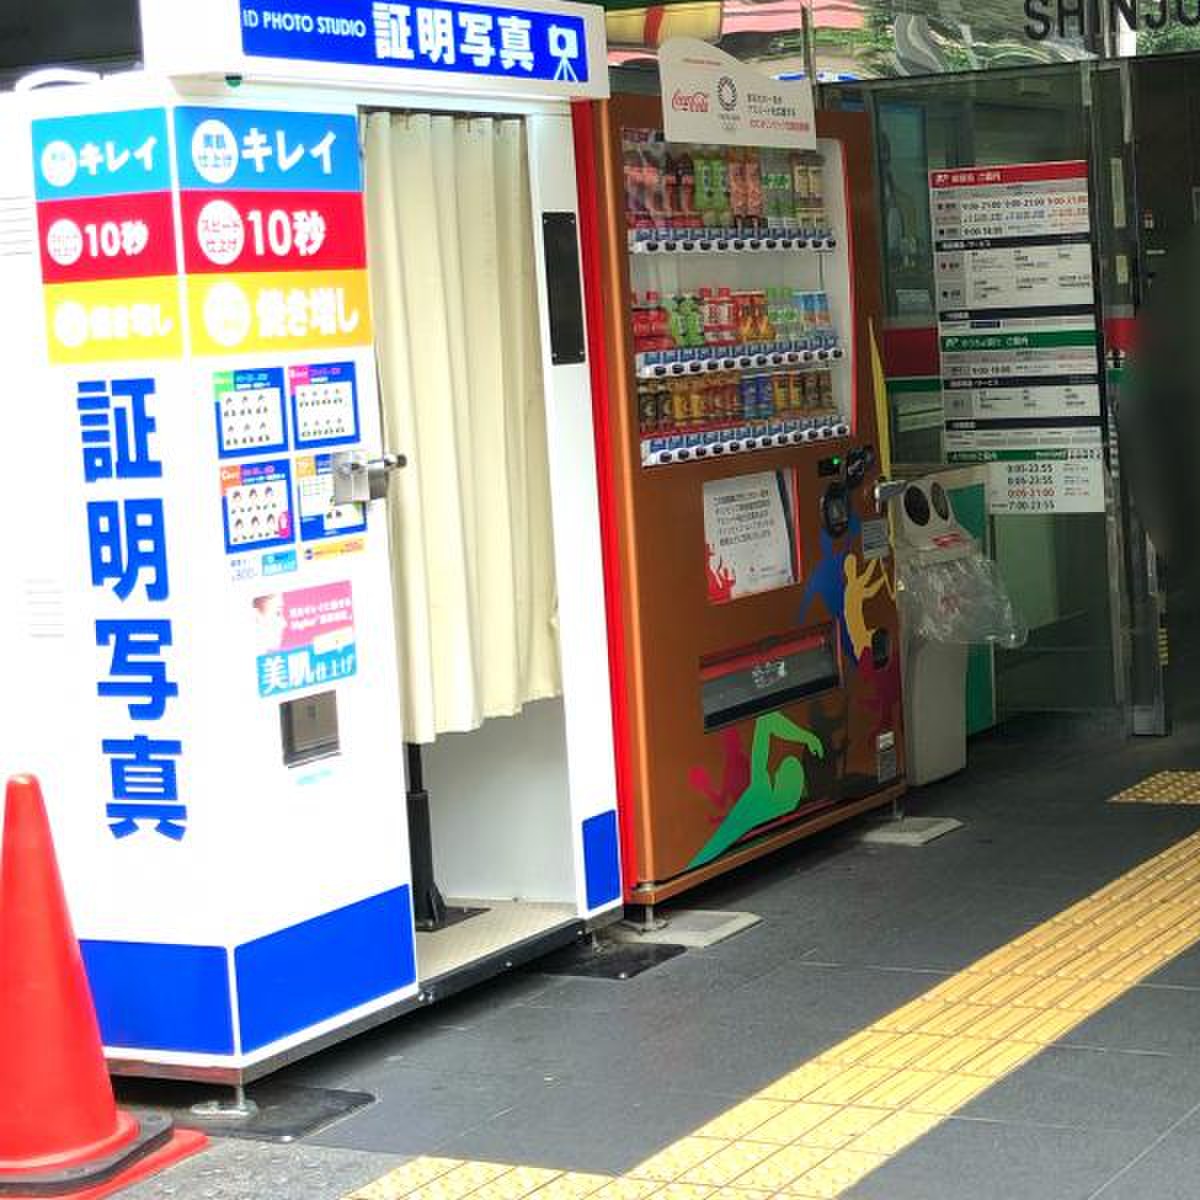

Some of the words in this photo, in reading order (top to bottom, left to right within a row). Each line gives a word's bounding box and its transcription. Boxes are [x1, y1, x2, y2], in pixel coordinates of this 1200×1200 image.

[243, 9, 259, 26] ID
[263, 11, 314, 33] PHOTO
[317, 14, 367, 38] STUDIO
[372, 0, 534, 72] 証明写真
[78, 135, 158, 176] キレイ
[241, 127, 337, 176] キレイ
[85, 220, 149, 257] 10秒
[248, 209, 327, 256] 10秒
[76, 377, 188, 841] 証明写真
